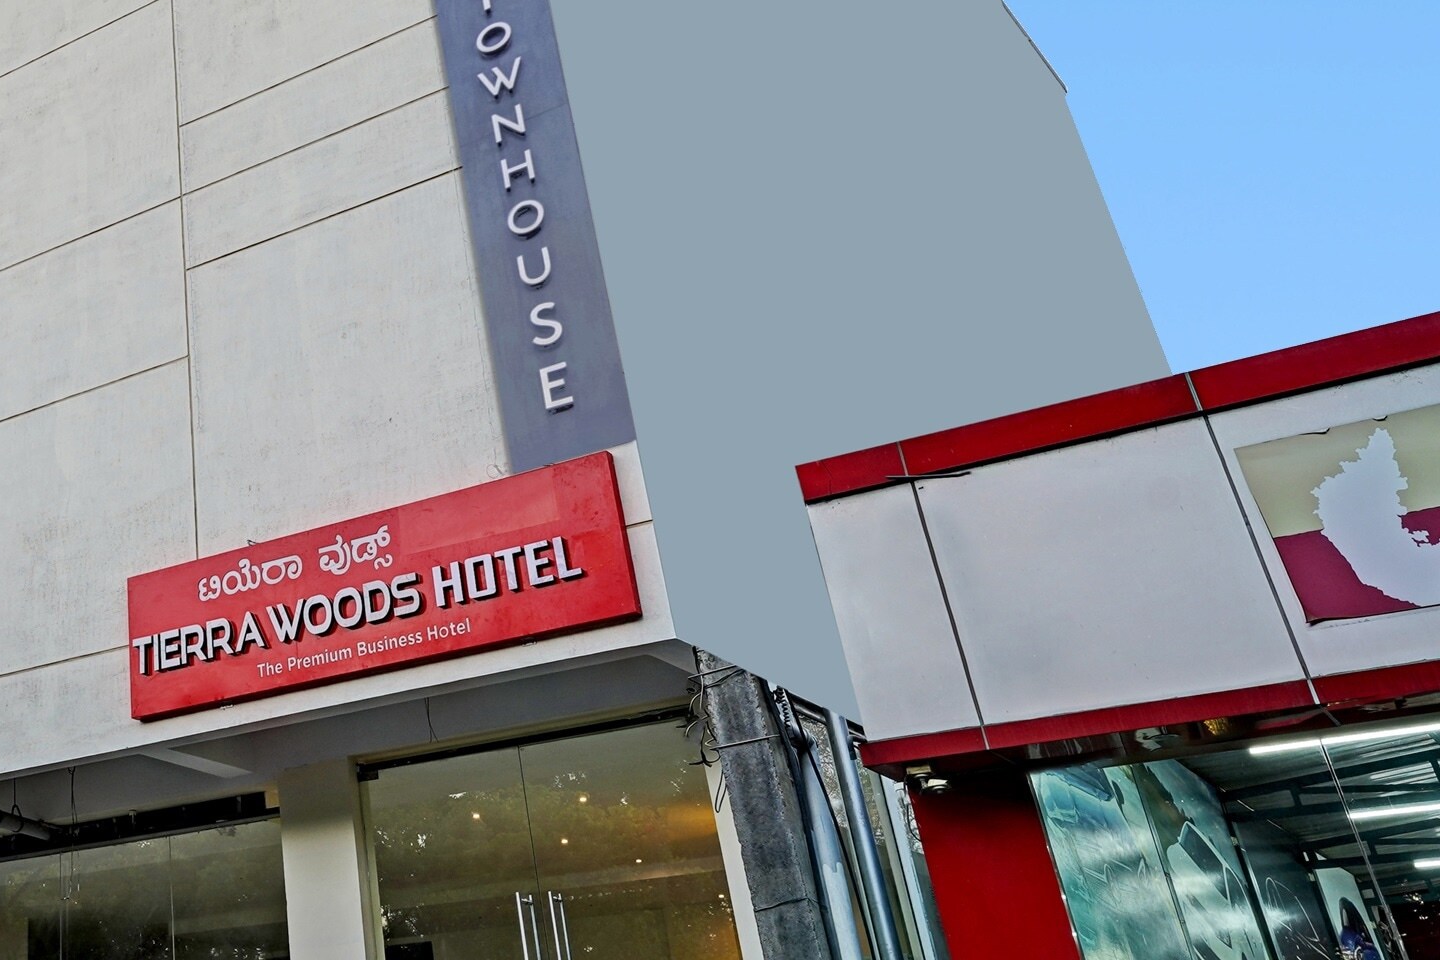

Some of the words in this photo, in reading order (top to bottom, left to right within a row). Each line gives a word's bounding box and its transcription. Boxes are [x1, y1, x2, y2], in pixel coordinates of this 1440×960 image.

[132, 610, 271, 677] TIERRA
[265, 571, 424, 644] WOODS
[431, 535, 583, 608] HOTEL
[256, 662, 284, 679] The
[287, 645, 353, 672] Premium
[357, 629, 423, 657] Business
[426, 617, 472, 640] Hotel
